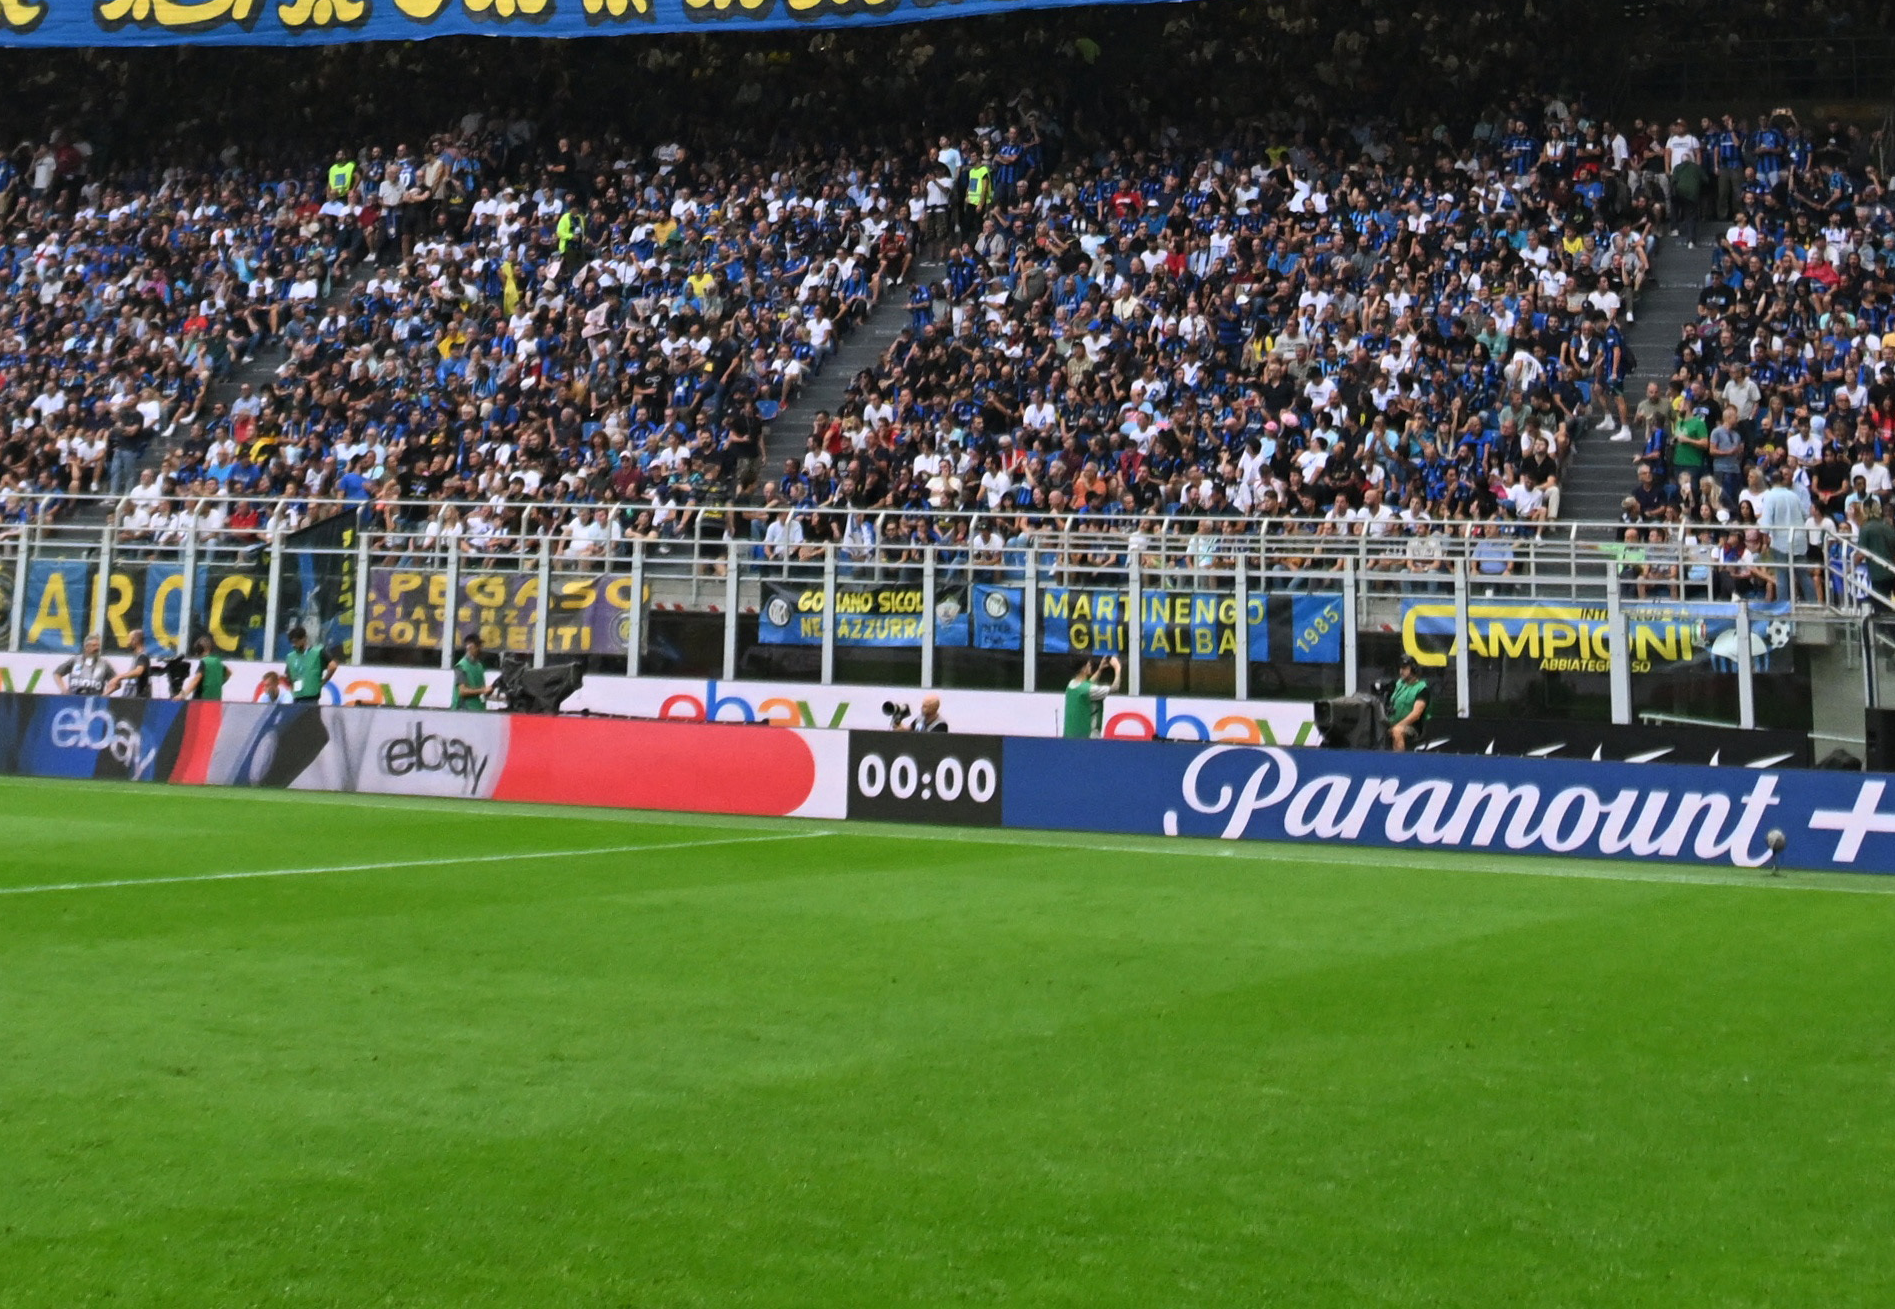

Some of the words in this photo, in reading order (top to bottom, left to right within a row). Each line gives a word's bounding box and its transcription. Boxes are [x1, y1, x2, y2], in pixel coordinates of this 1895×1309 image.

[388, 572, 651, 610] PEGASO
[797, 590, 874, 615] GOIANO
[877, 589, 925, 614] SICOL
[1042, 591, 1265, 625] MARTINENGO
[1069, 622, 1237, 655] GHIALBA
[1295, 604, 1340, 654] 1985
[1402, 604, 1694, 667] CAMPIONI
[1539, 657, 1652, 673] ABBIATEGSO
[51, 696, 157, 781] ebay
[381, 721, 489, 796] ebay
[857, 753, 998, 805] 00:00
